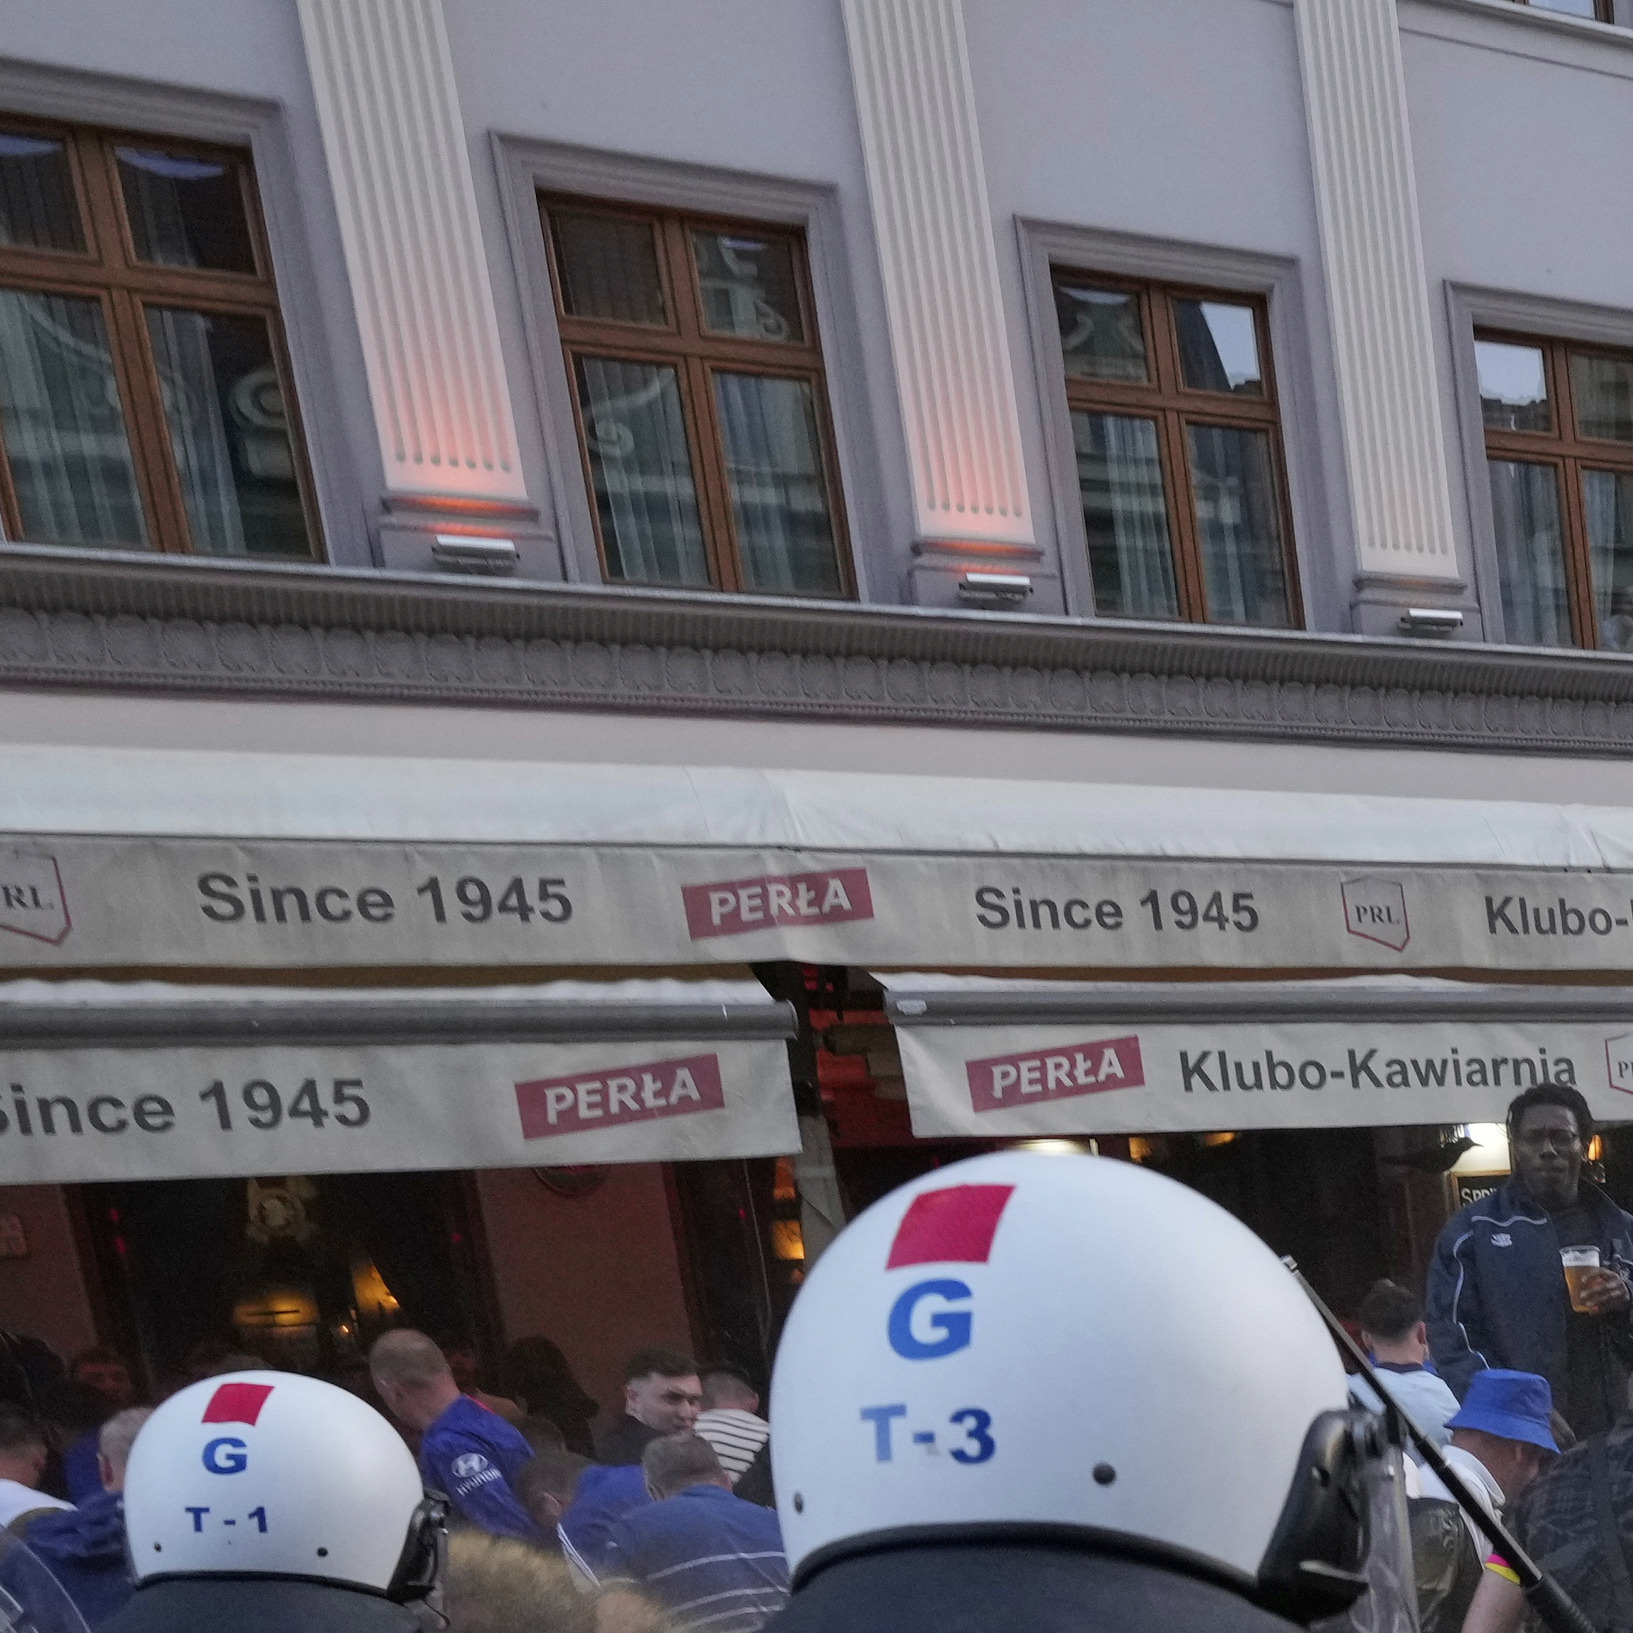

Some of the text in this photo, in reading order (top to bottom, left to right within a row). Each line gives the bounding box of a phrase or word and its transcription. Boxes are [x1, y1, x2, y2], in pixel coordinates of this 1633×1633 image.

[197, 871, 575, 925] Since 1945
[709, 875, 853, 927] PERŁA
[975, 886, 1261, 934] Since 1945
[1354, 903, 1400, 926] PRL
[991, 1046, 1126, 1100] PERŁA
[1179, 1047, 1577, 1093] Klubo-Kawiarnia
[0, 1074, 372, 1137] ince 1945
[545, 1074, 703, 1125] PERŁA
[887, 1278, 973, 1361] G
[201, 1437, 249, 1475] G
[859, 1403, 997, 1465] T-3
